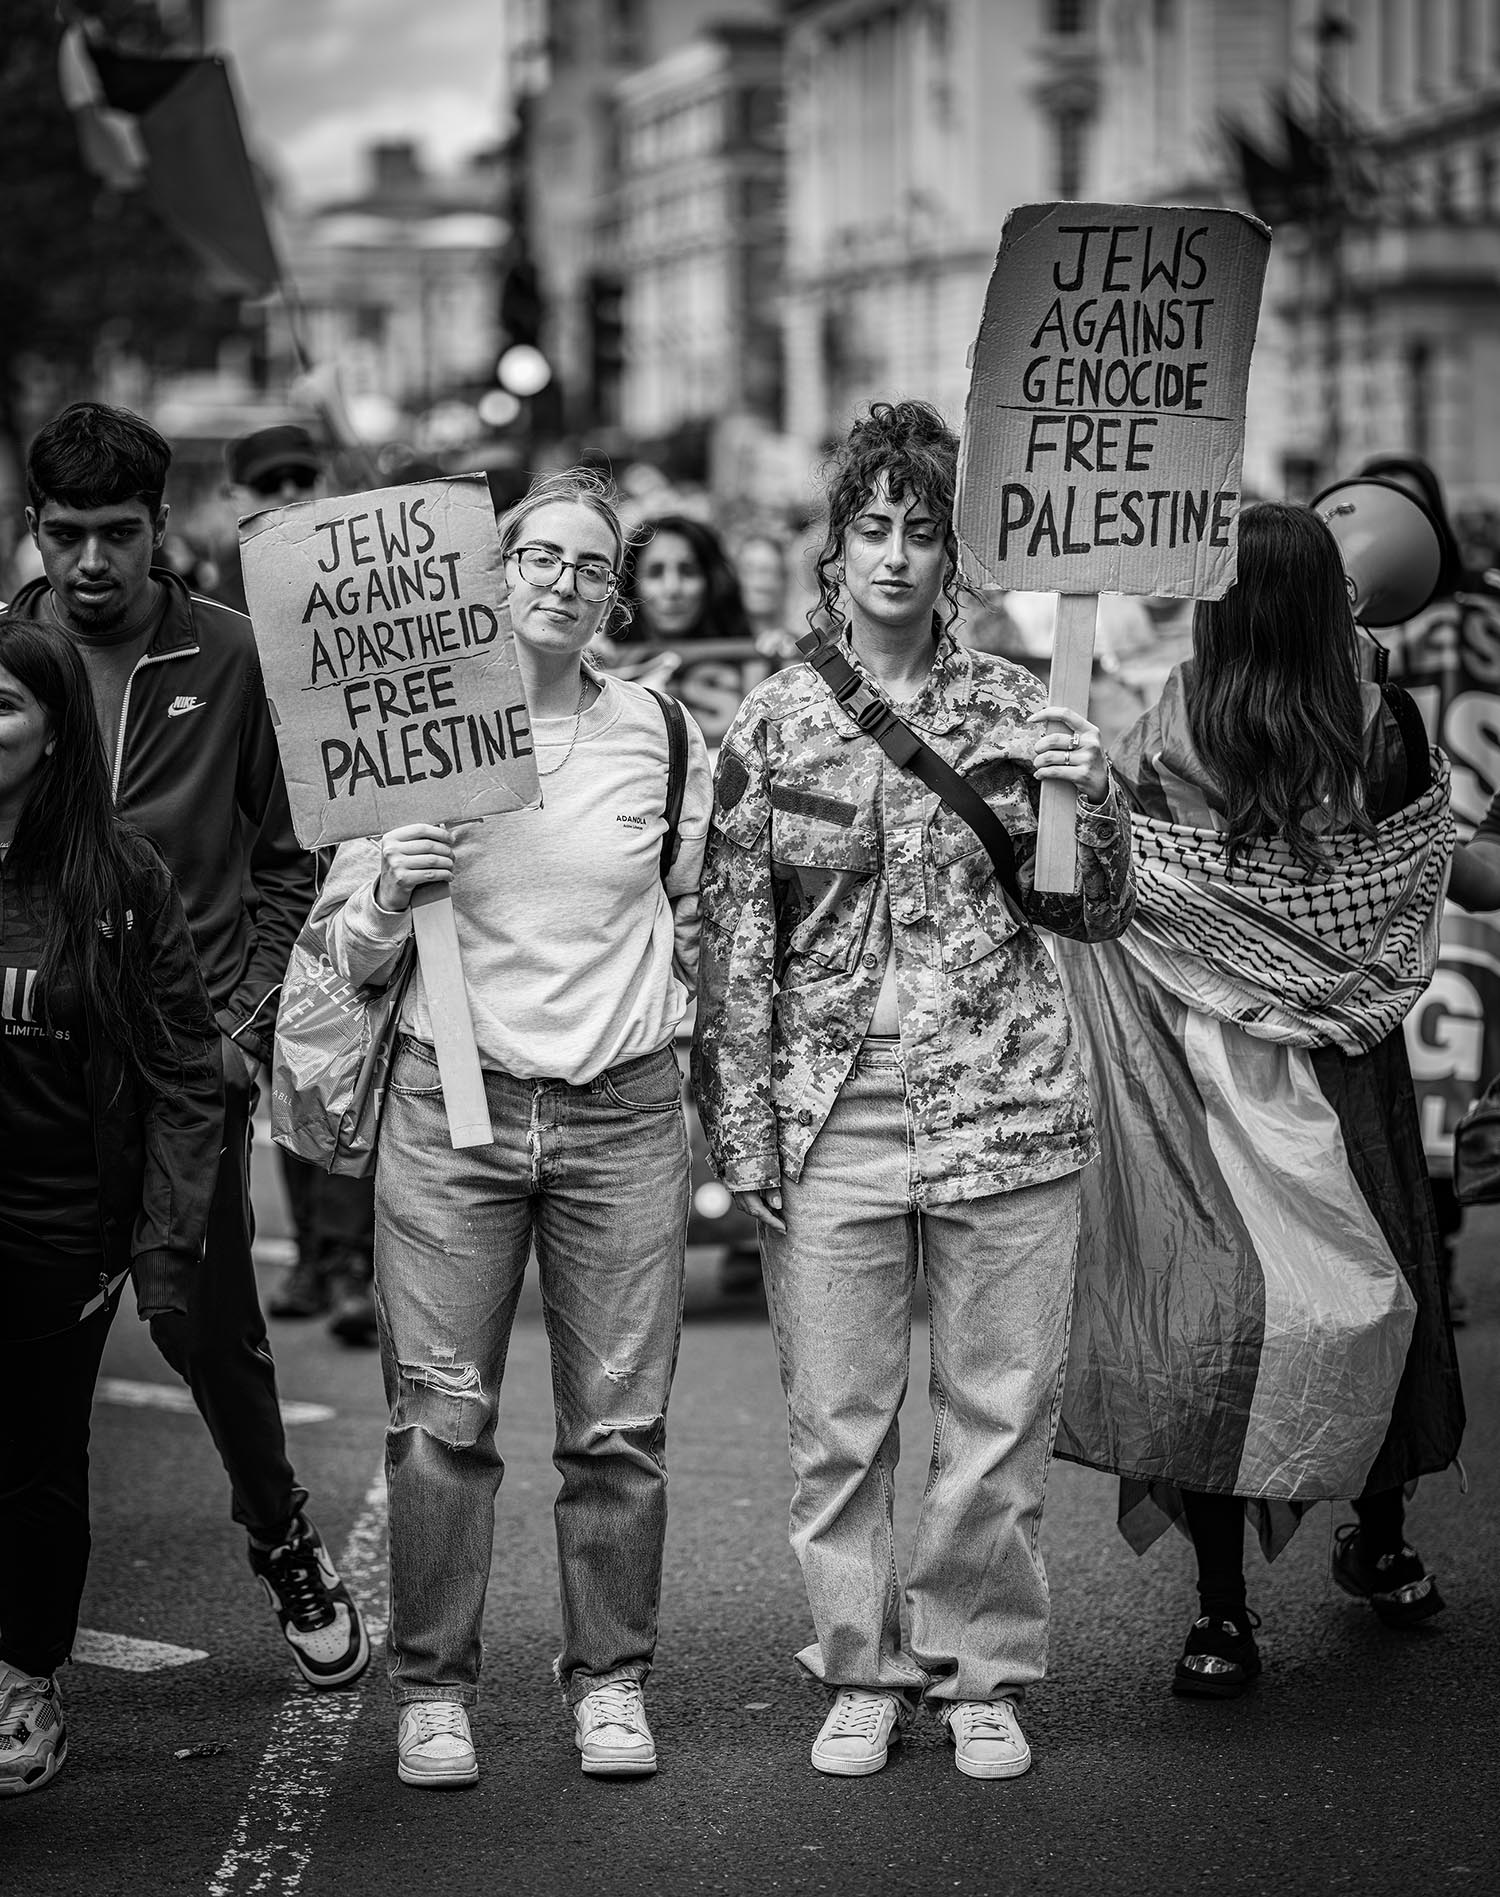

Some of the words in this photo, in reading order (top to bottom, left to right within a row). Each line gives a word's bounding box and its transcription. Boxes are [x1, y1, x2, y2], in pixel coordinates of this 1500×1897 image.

[1053, 225, 1209, 293] JEWS
[1030, 297, 1215, 357] AGAINST
[1022, 355, 1209, 410] GENOCIDE
[1025, 414, 1158, 473] FREE
[314, 498, 436, 573] JEWS
[998, 483, 1239, 561] PALESTINE
[301, 551, 461, 624] AGAINST
[310, 603, 499, 684] APARTHEID
[173, 696, 198, 709] NIKE
[343, 665, 457, 730] FREE
[320, 704, 533, 800] PALESTINE
[4, 1024, 71, 1041] LIMITLSS
